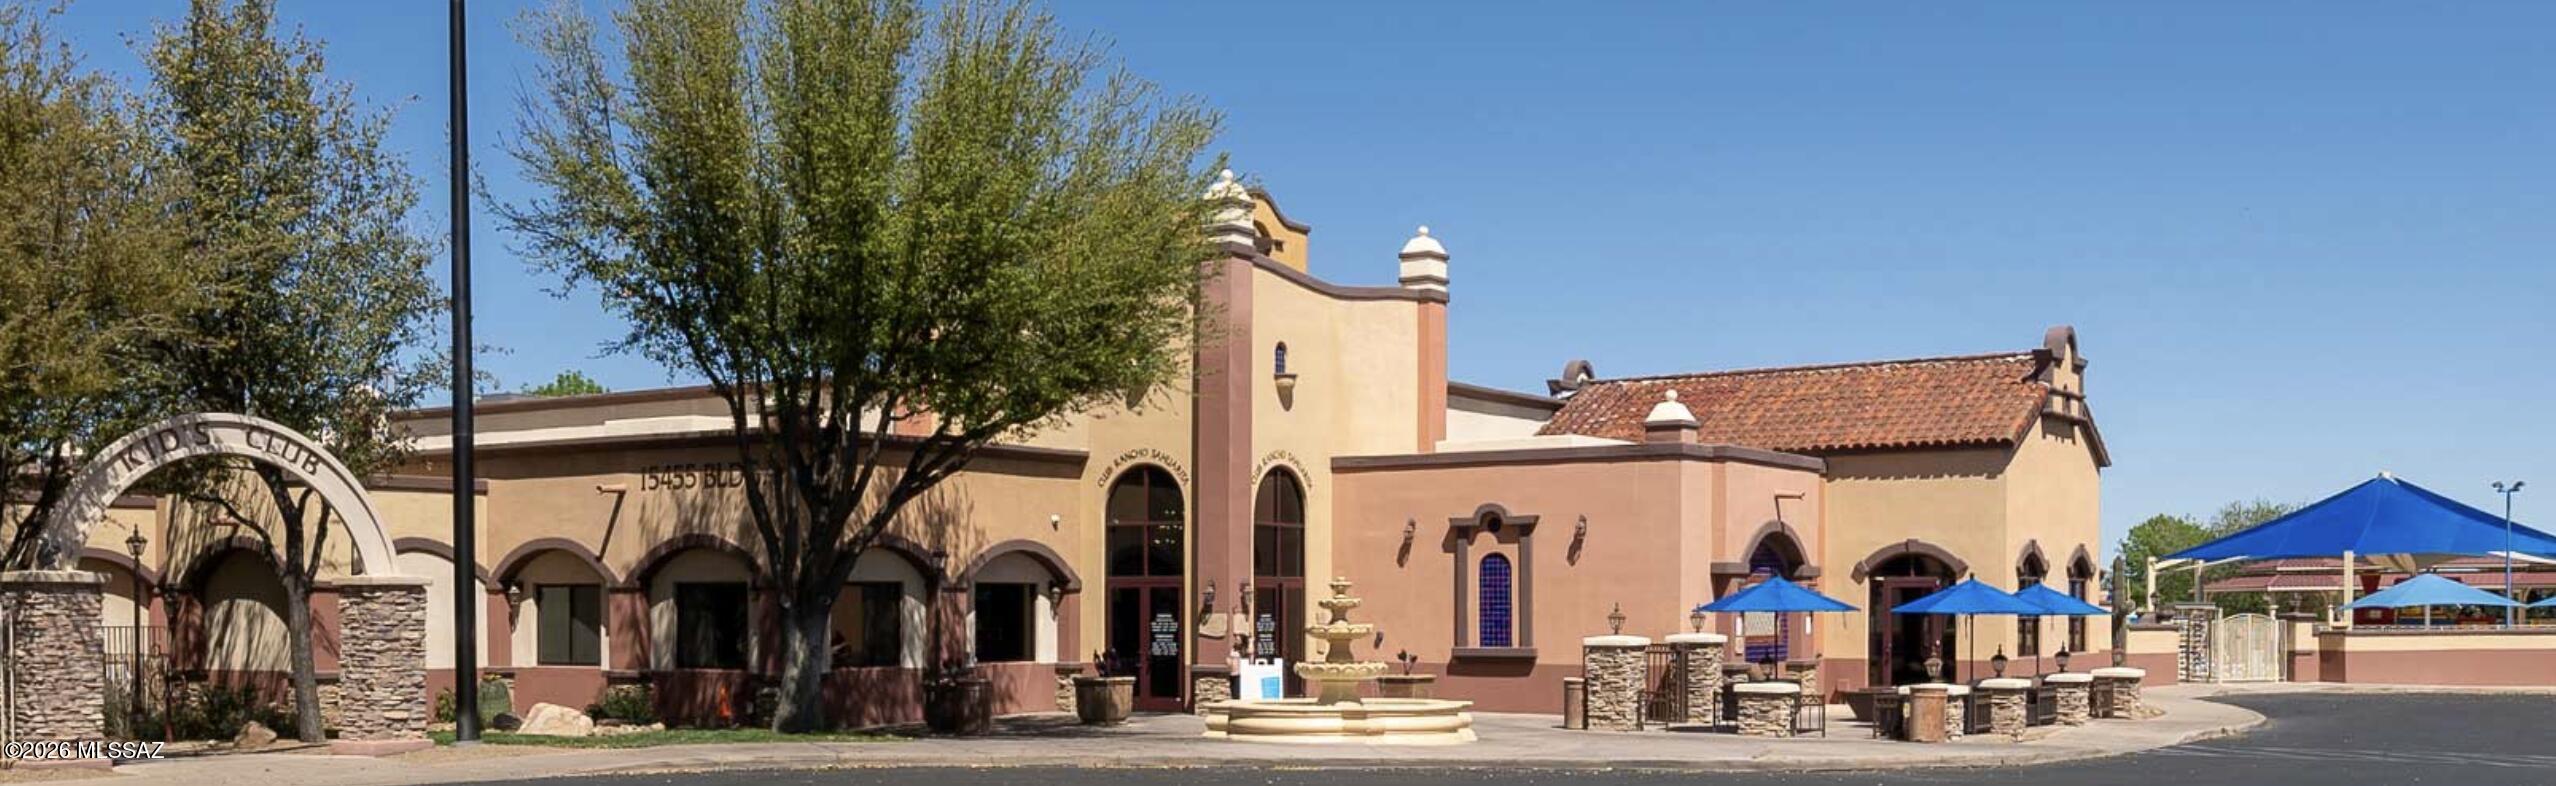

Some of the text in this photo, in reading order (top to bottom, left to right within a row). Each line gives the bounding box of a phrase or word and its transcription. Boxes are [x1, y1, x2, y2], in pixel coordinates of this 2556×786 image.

[121, 422, 323, 476] KID'S CLUB
[641, 464, 697, 491] 15455
[1097, 465, 1114, 488] CLUB
